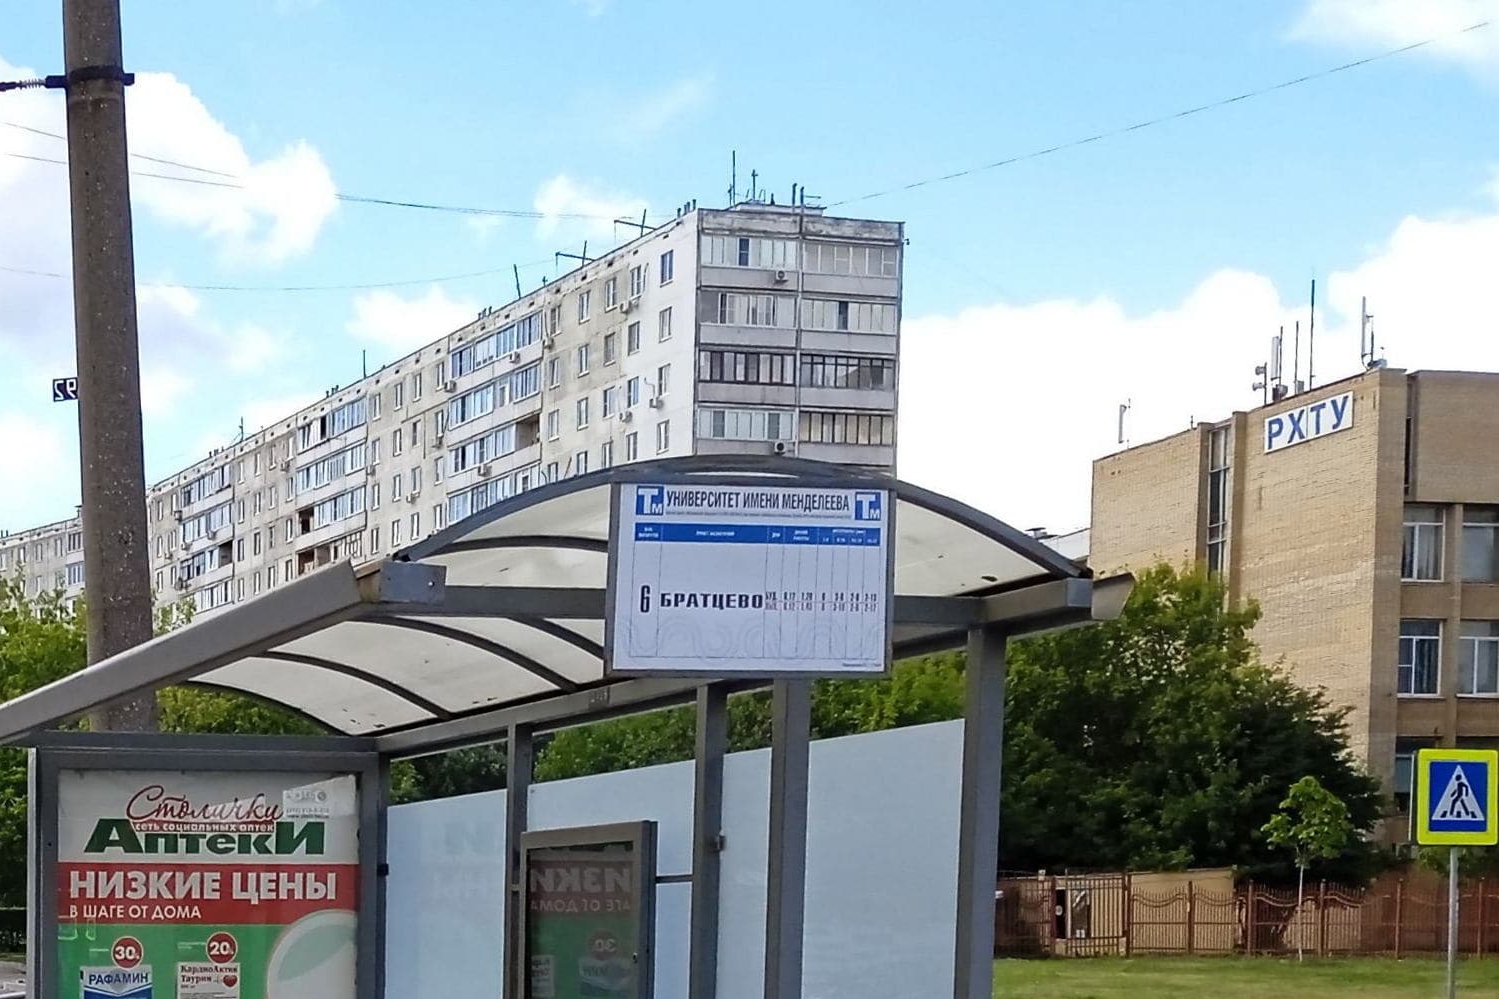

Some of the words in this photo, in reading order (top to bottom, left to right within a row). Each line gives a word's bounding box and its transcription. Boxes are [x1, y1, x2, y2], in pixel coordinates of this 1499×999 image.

[1268, 395, 1349, 450] РХТУ
[666, 490, 741, 508] УНИВЕРСИТЕТ
[743, 492, 780, 509] ИМЕНИ
[782, 493, 850, 512] МЕНДЕЛЕЕВА
[640, 585, 651, 613] 6
[660, 592, 763, 610] БРАТЦЕВО
[126, 785, 283, 822] Столички
[135, 823, 160, 832] сеть
[163, 823, 237, 833] социальных
[240, 823, 275, 832] аптек
[69, 871, 221, 899] НИЗКИЕ
[232, 872, 337, 904] ЦЕНЫ
[69, 905, 78, 918] В
[83, 905, 125, 918] ШАГЕ
[128, 905, 149, 918] ОТ
[152, 905, 202, 920] ДОМА
[88, 972, 149, 986] РАФАМИН
